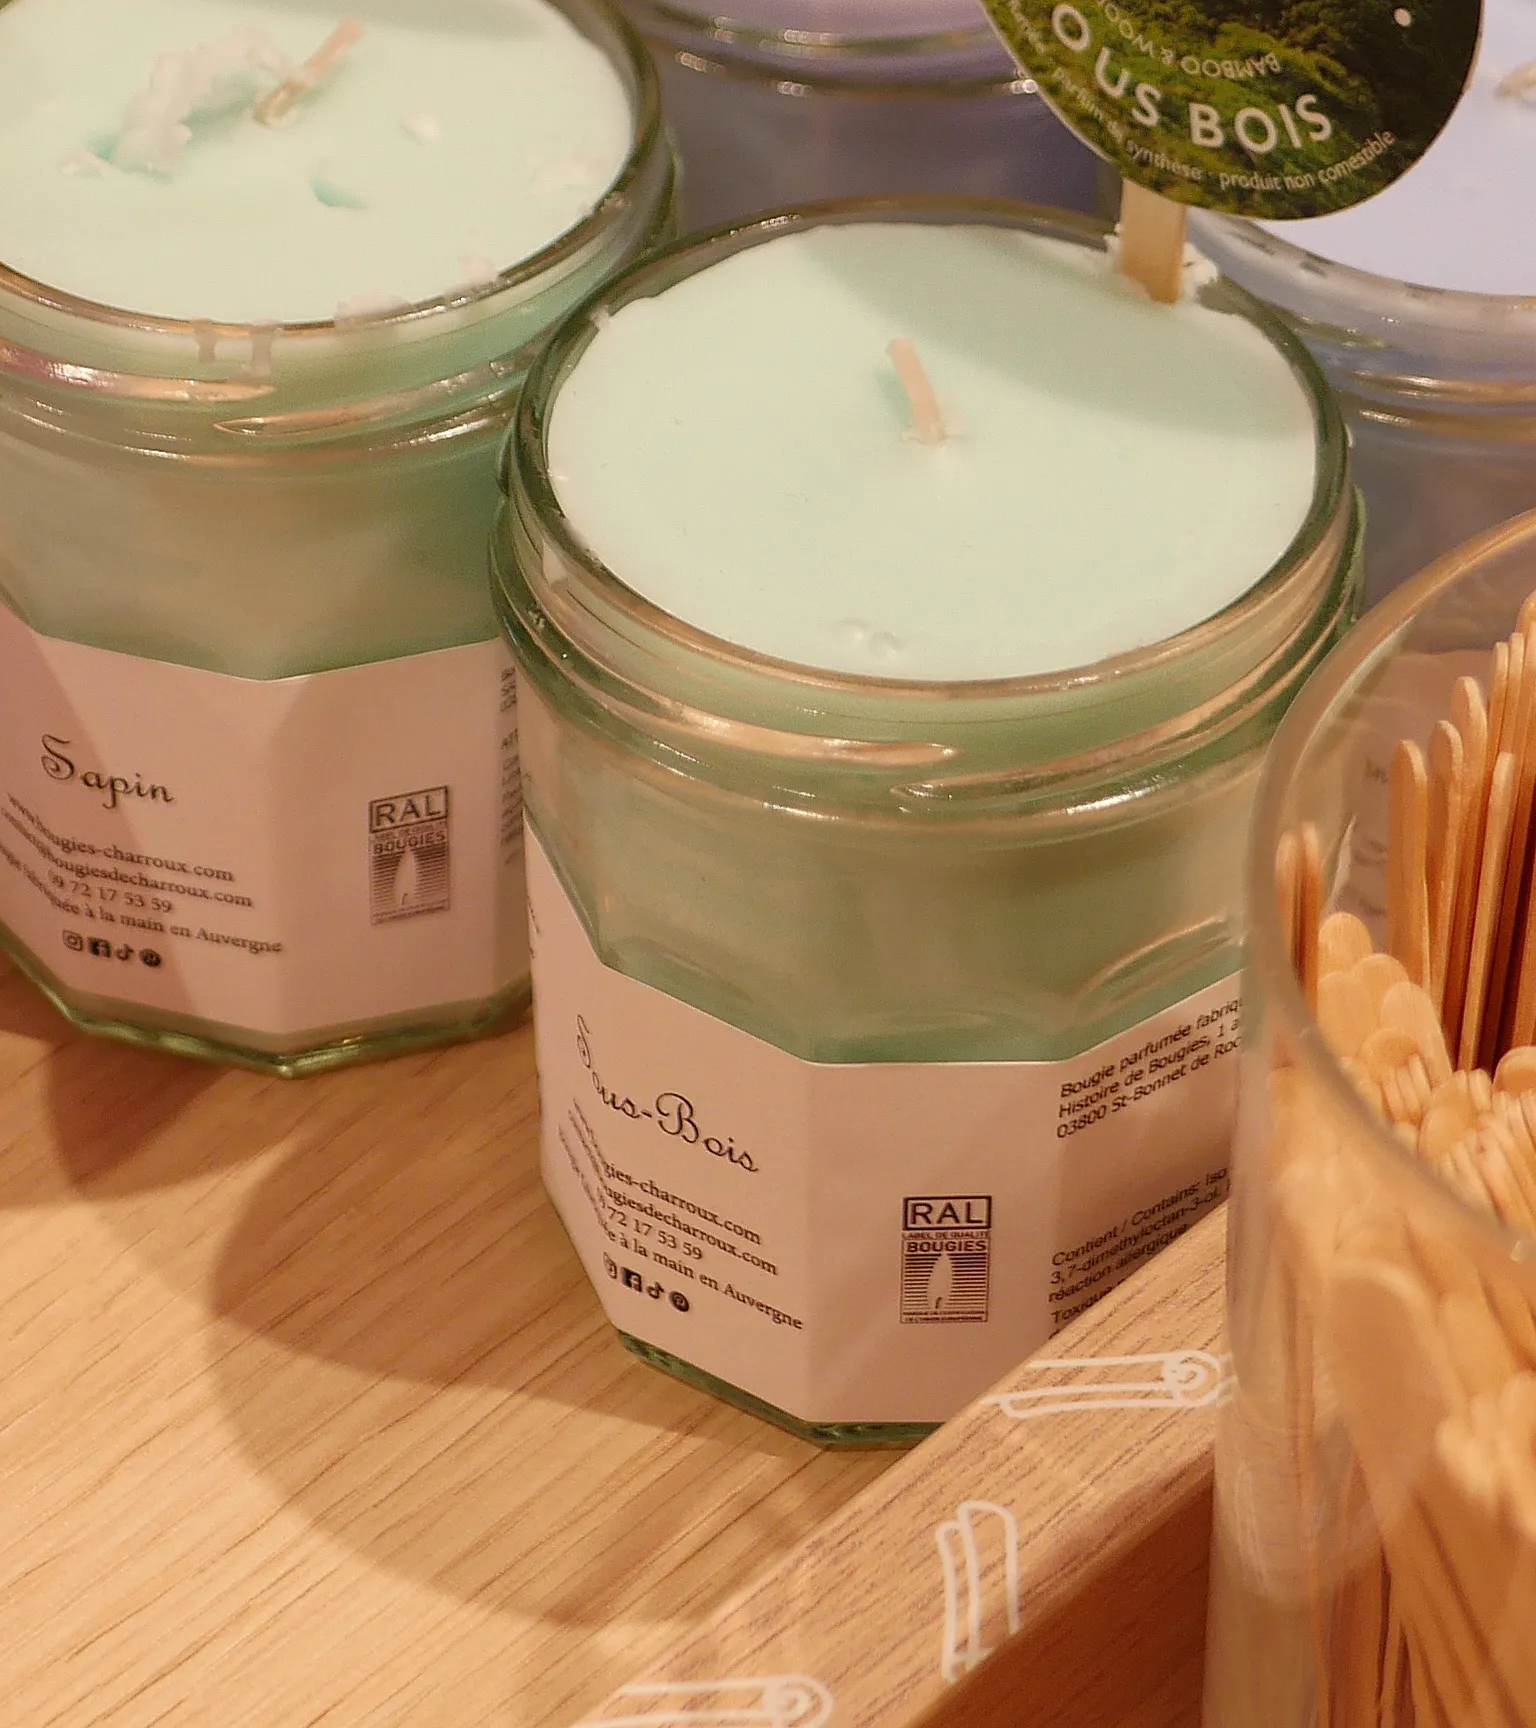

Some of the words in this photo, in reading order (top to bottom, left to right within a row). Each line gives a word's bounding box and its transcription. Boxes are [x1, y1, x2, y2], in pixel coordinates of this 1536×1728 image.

[1179, 51, 1282, 80] BAMBOO
[1188, 92, 1332, 154] BOIS
[1218, 170, 1281, 192] produit
[1283, 171, 1315, 189] non
[1317, 129, 1395, 185] comestible
[40, 734, 174, 809] Sapin
[375, 794, 442, 827] RAL
[374, 831, 446, 855] BOUGIES
[71, 880, 92, 898] 72
[99, 885, 117, 901] 17
[124, 891, 145, 908] 53
[151, 897, 173, 914] 59
[84, 902, 95, 919] à
[99, 906, 115, 923] la
[120, 912, 164, 933] main
[171, 923, 190, 938] en
[196, 927, 283, 956] Auvergne
[1058, 1080, 1120, 1118] Histoire
[1124, 1069, 1144, 1086] de
[1217, 1024, 1225, 1040] 1
[1061, 1064, 1116, 1098] Bougie
[1119, 1023, 1192, 1075] parfumée
[1195, 997, 1242, 1030] fabriq
[576, 1014, 759, 1173] Sous-Bois
[1056, 1104, 1107, 1139] 03800
[1111, 1067, 1187, 1113] St-Bonnet
[1190, 1053, 1210, 1072] de
[607, 1205, 627, 1227] 72
[633, 1218, 652, 1237] 17
[657, 1229, 677, 1249] 53
[682, 1241, 703, 1261] 59
[902, 1231, 934, 1240] LABEL
[909, 1201, 984, 1224] RAL
[1052, 1219, 1120, 1268] Contient
[1131, 1182, 1200, 1225] Contains:
[906, 1240, 987, 1253] BOUGIES
[619, 1232, 629, 1248] à
[633, 1241, 648, 1258] la
[653, 1252, 695, 1280] main
[699, 1273, 719, 1291] en
[723, 1284, 803, 1330] Auvergne
[1049, 1263, 1113, 1304] réaction
